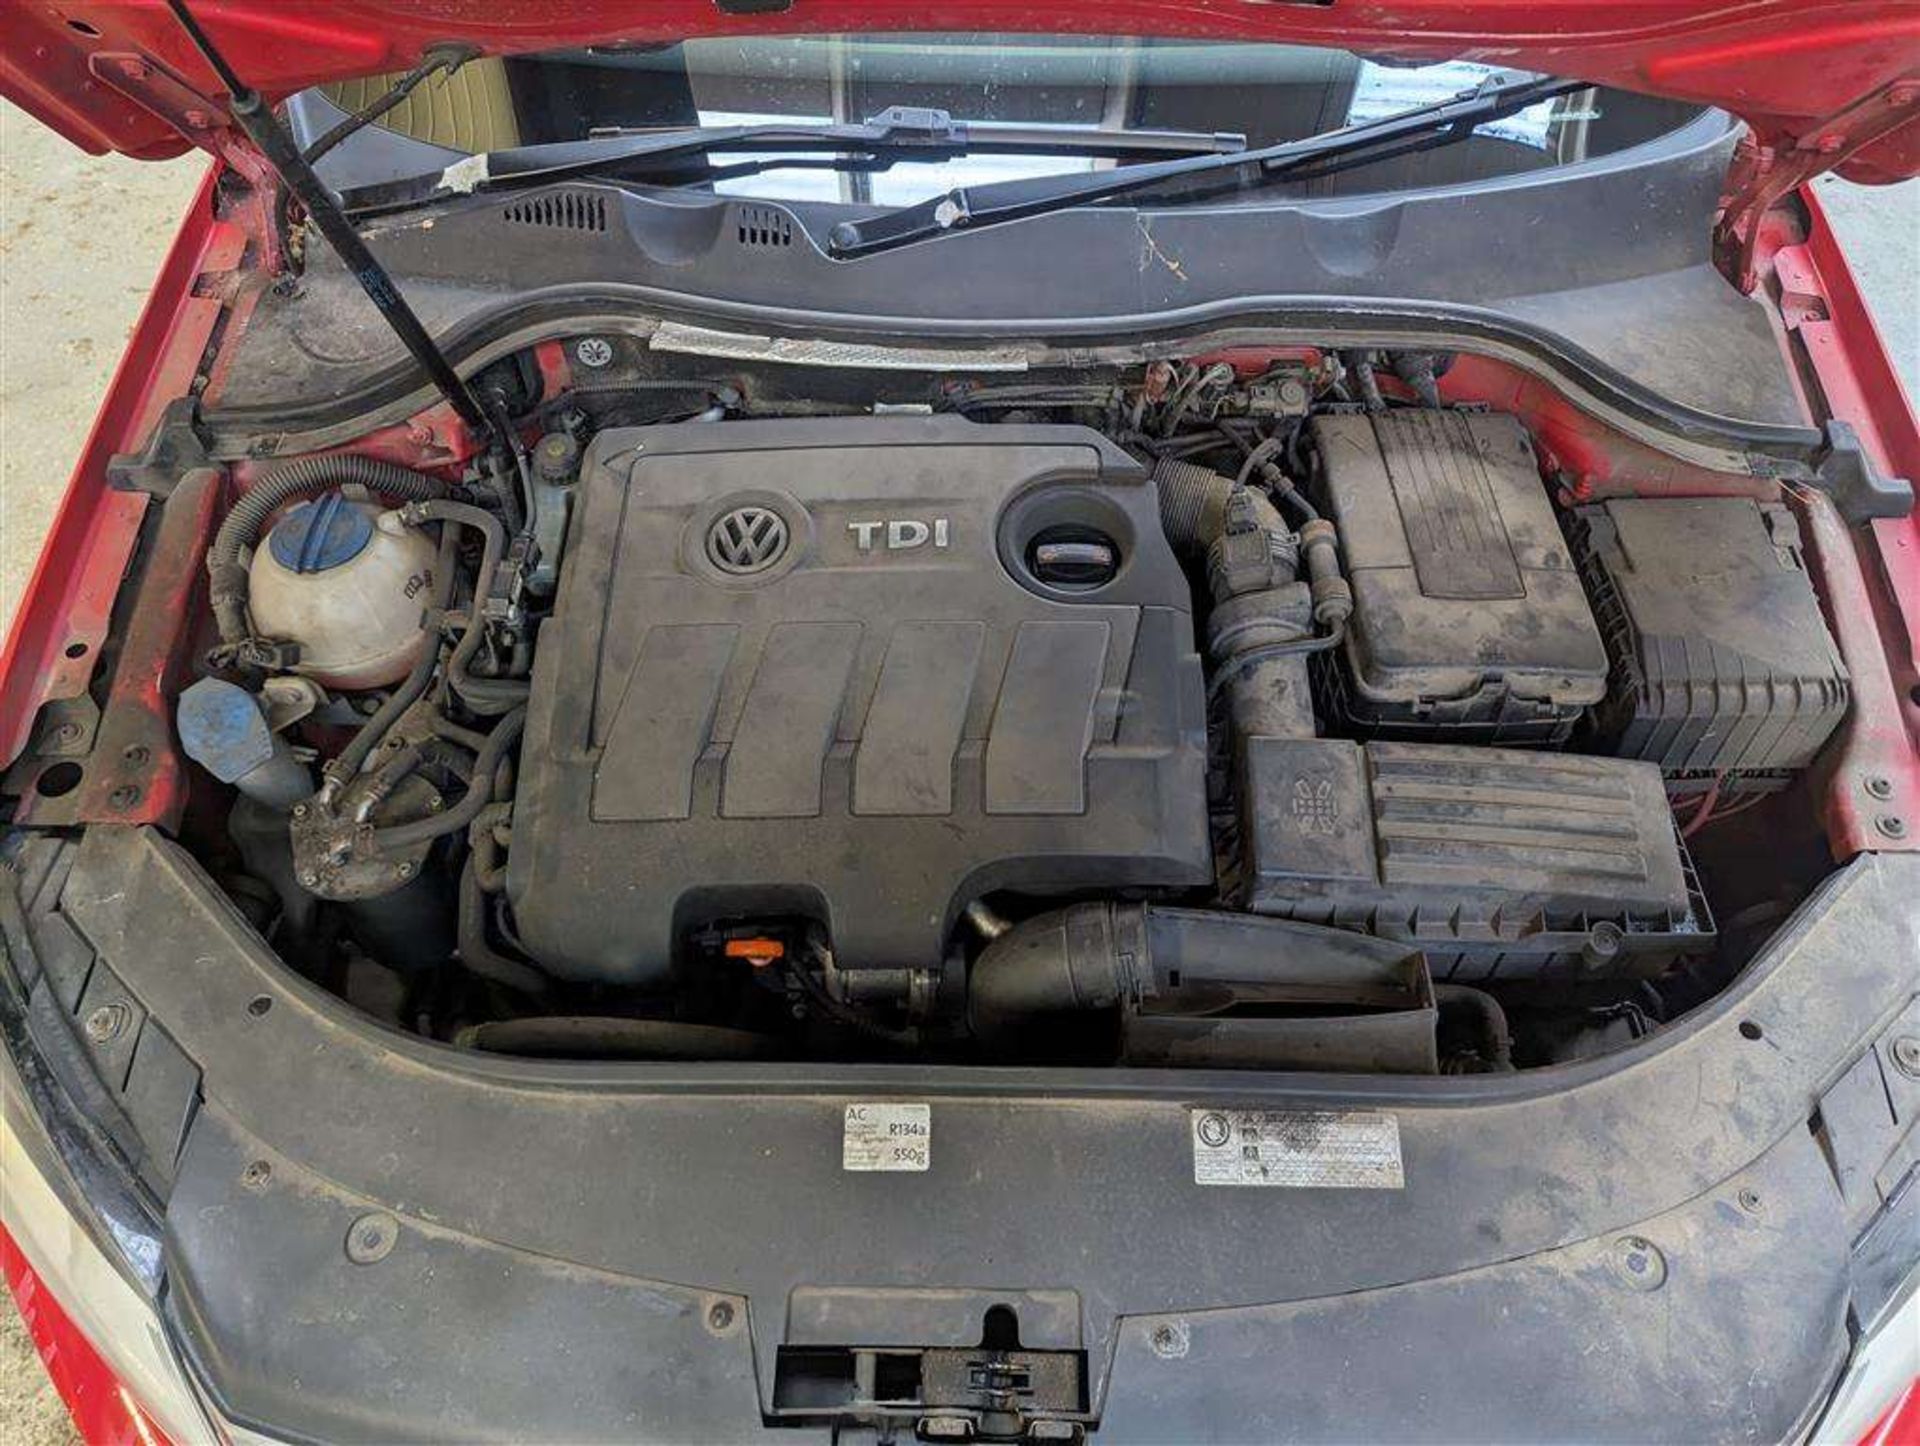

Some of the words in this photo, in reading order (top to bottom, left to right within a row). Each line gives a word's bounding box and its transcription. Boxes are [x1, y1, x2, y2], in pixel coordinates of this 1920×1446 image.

[849, 519, 948, 549] TDI
[847, 1107, 867, 1121] AC
[889, 1123, 926, 1136] R134a
[893, 1148, 925, 1166] 550g
